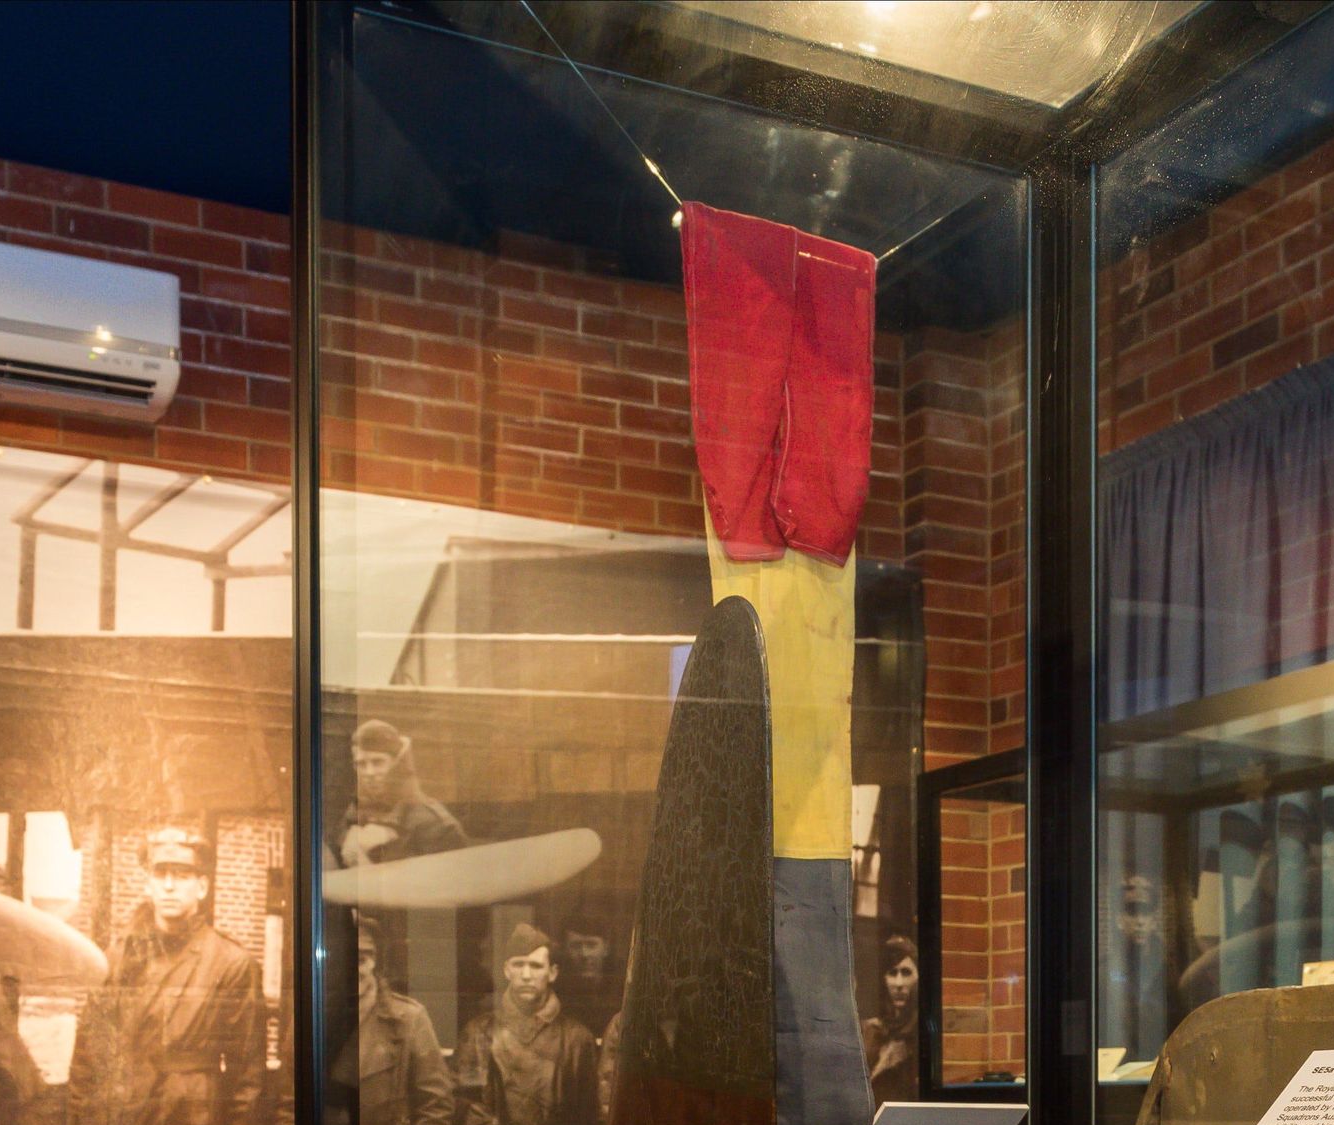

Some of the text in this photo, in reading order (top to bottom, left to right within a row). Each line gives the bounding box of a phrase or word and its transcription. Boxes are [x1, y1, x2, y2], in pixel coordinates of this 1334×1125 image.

[1312, 1066, 1334, 1074] SE5a
[1291, 1094, 1334, 1102] successful
[1284, 1104, 1321, 1112] operated
[1277, 1114, 1320, 1122] Squadrons
